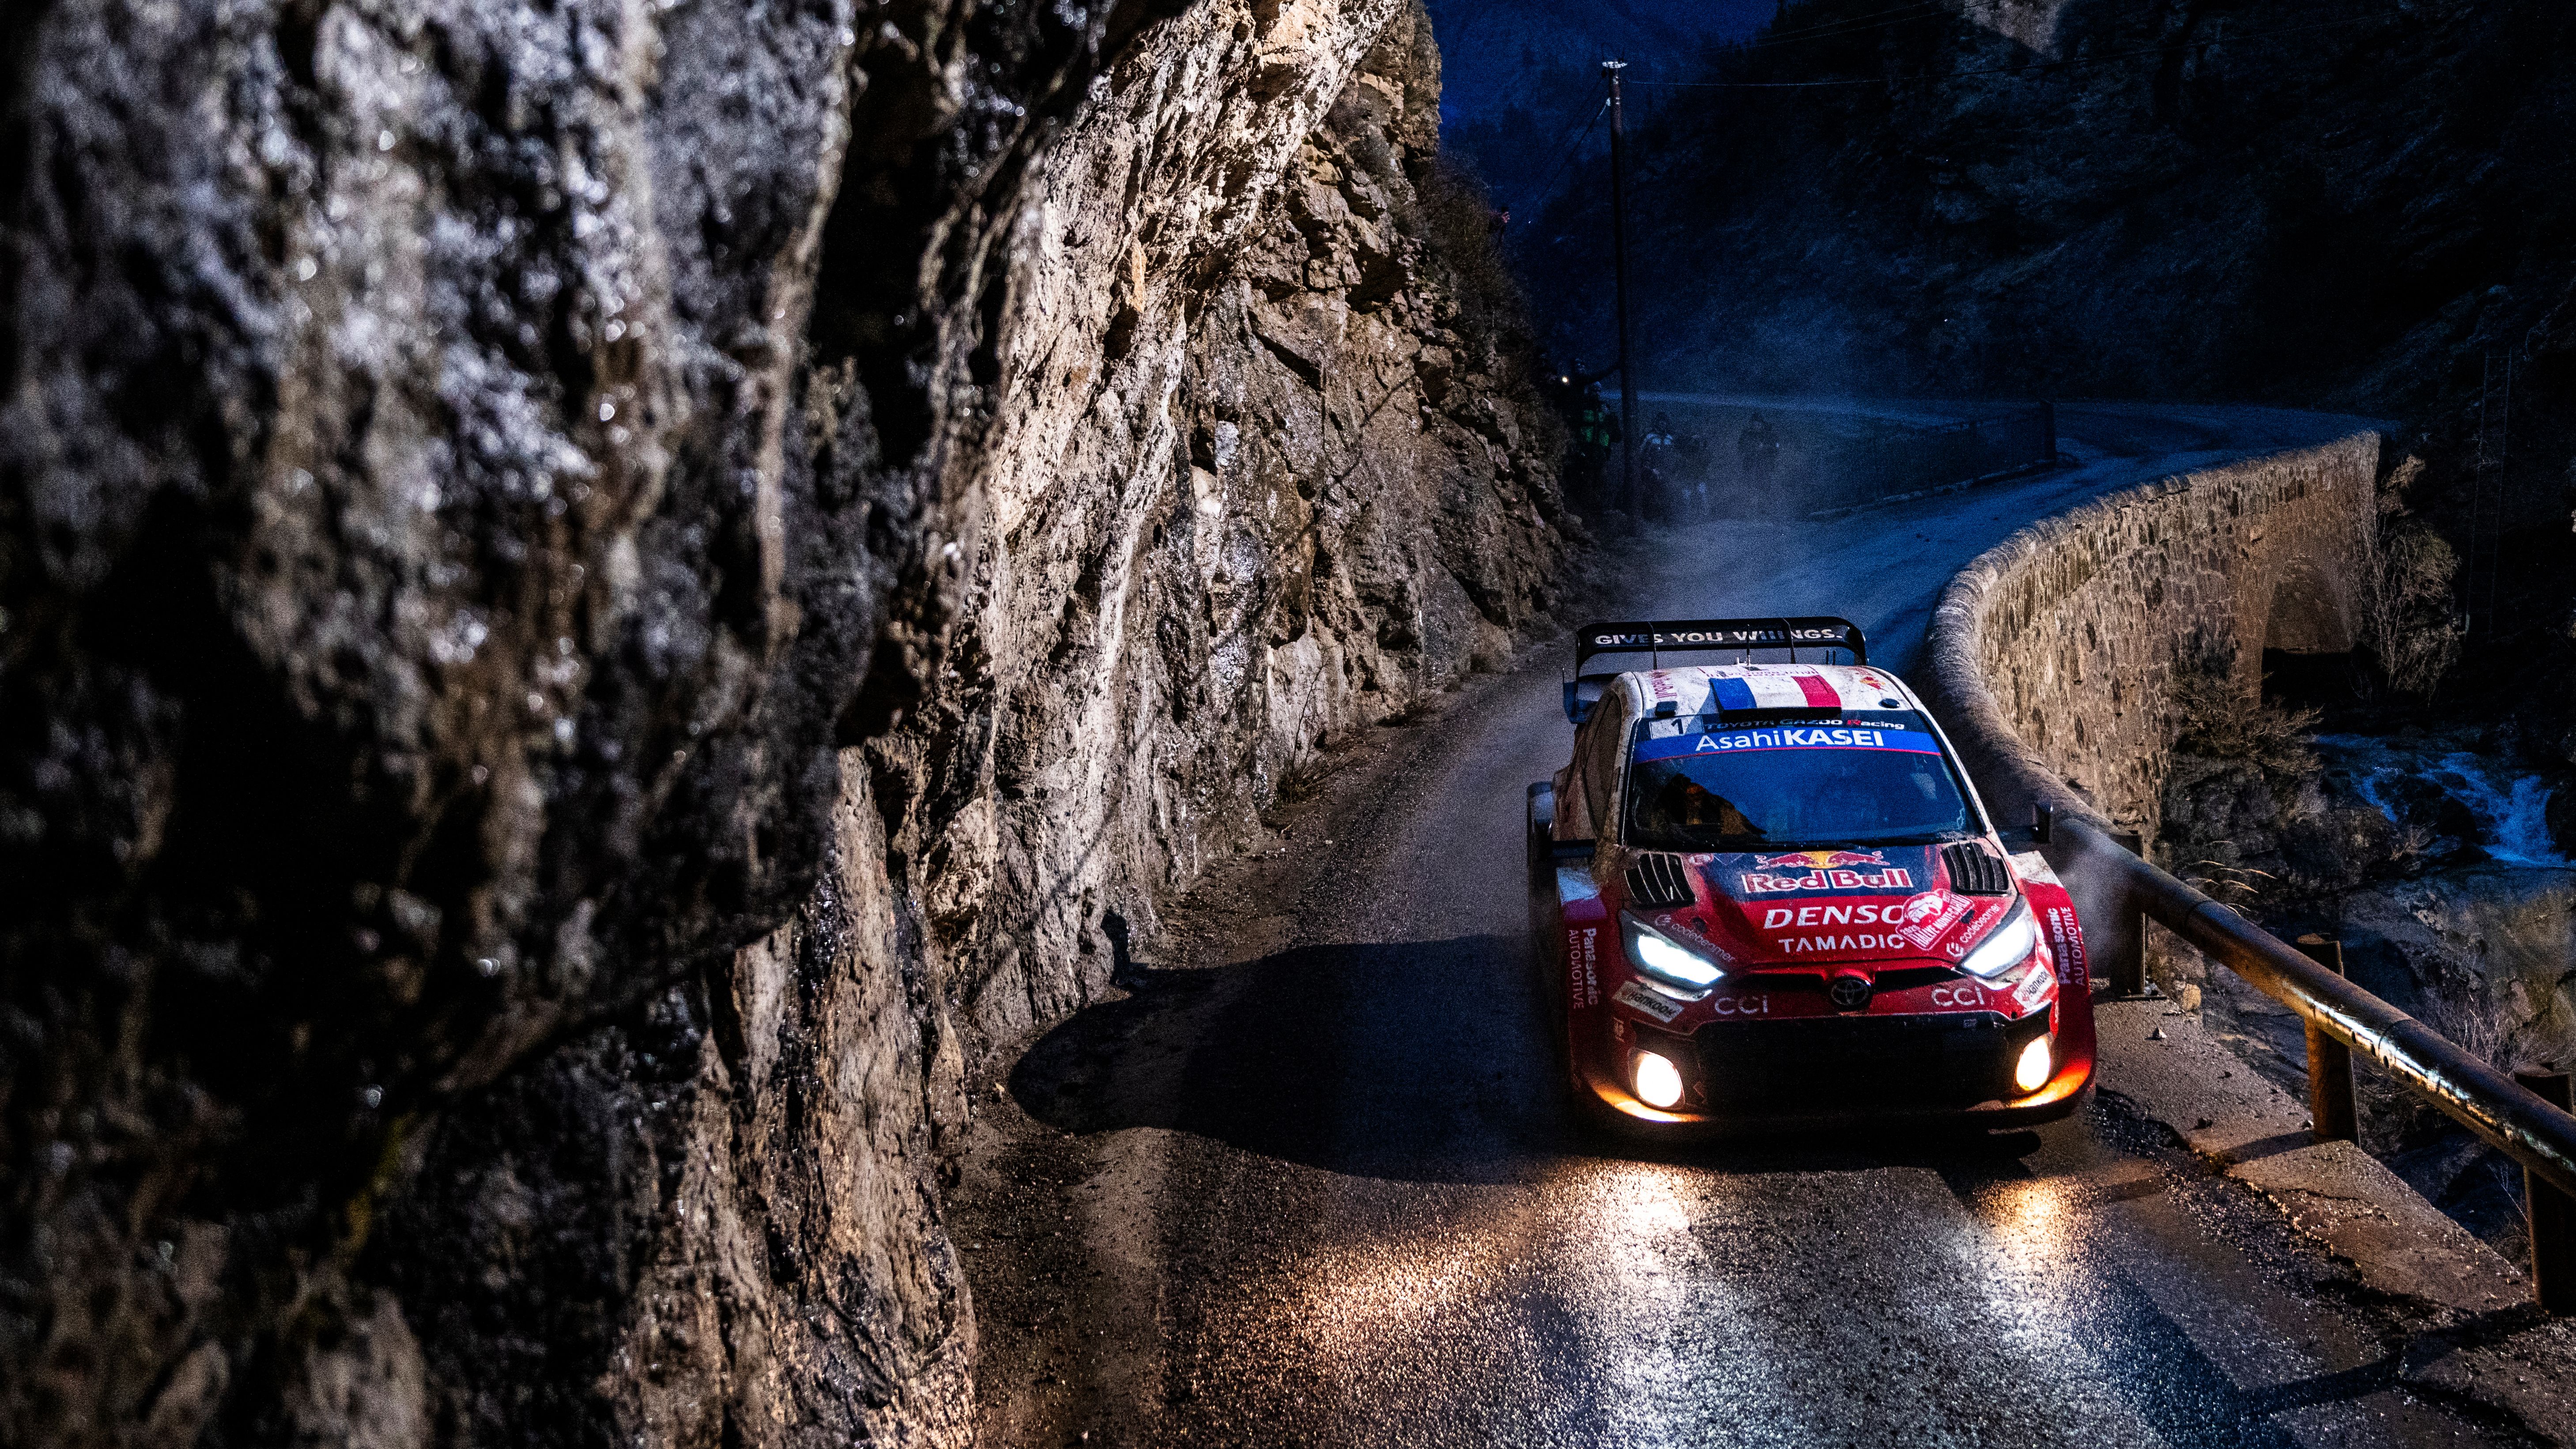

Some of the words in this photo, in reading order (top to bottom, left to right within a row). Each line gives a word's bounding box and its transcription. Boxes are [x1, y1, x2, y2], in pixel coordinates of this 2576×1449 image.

[1594, 634, 1664, 645] GIVES
[1670, 632, 1724, 642] YOU
[1671, 718, 1685, 735] 1
[1704, 720, 1775, 729] TOYOTA
[1779, 719, 1843, 727] GAZOO
[1847, 719, 1905, 730] Racing
[1741, 869, 1829, 893] Red
[1828, 868, 1914, 889] Bull
[1763, 905, 1904, 929] DENSO
[1960, 903, 2000, 943] codebeamer
[1671, 923, 1735, 962] codebeamer
[1778, 933, 1905, 953] TAMADIC
[1908, 924, 1940, 947] RALLYE
[2047, 907, 2071, 985] Panasonic
[2059, 906, 2085, 986] AUTOMOTIVE
[1569, 929, 1584, 1009] AUTOMOTIVE
